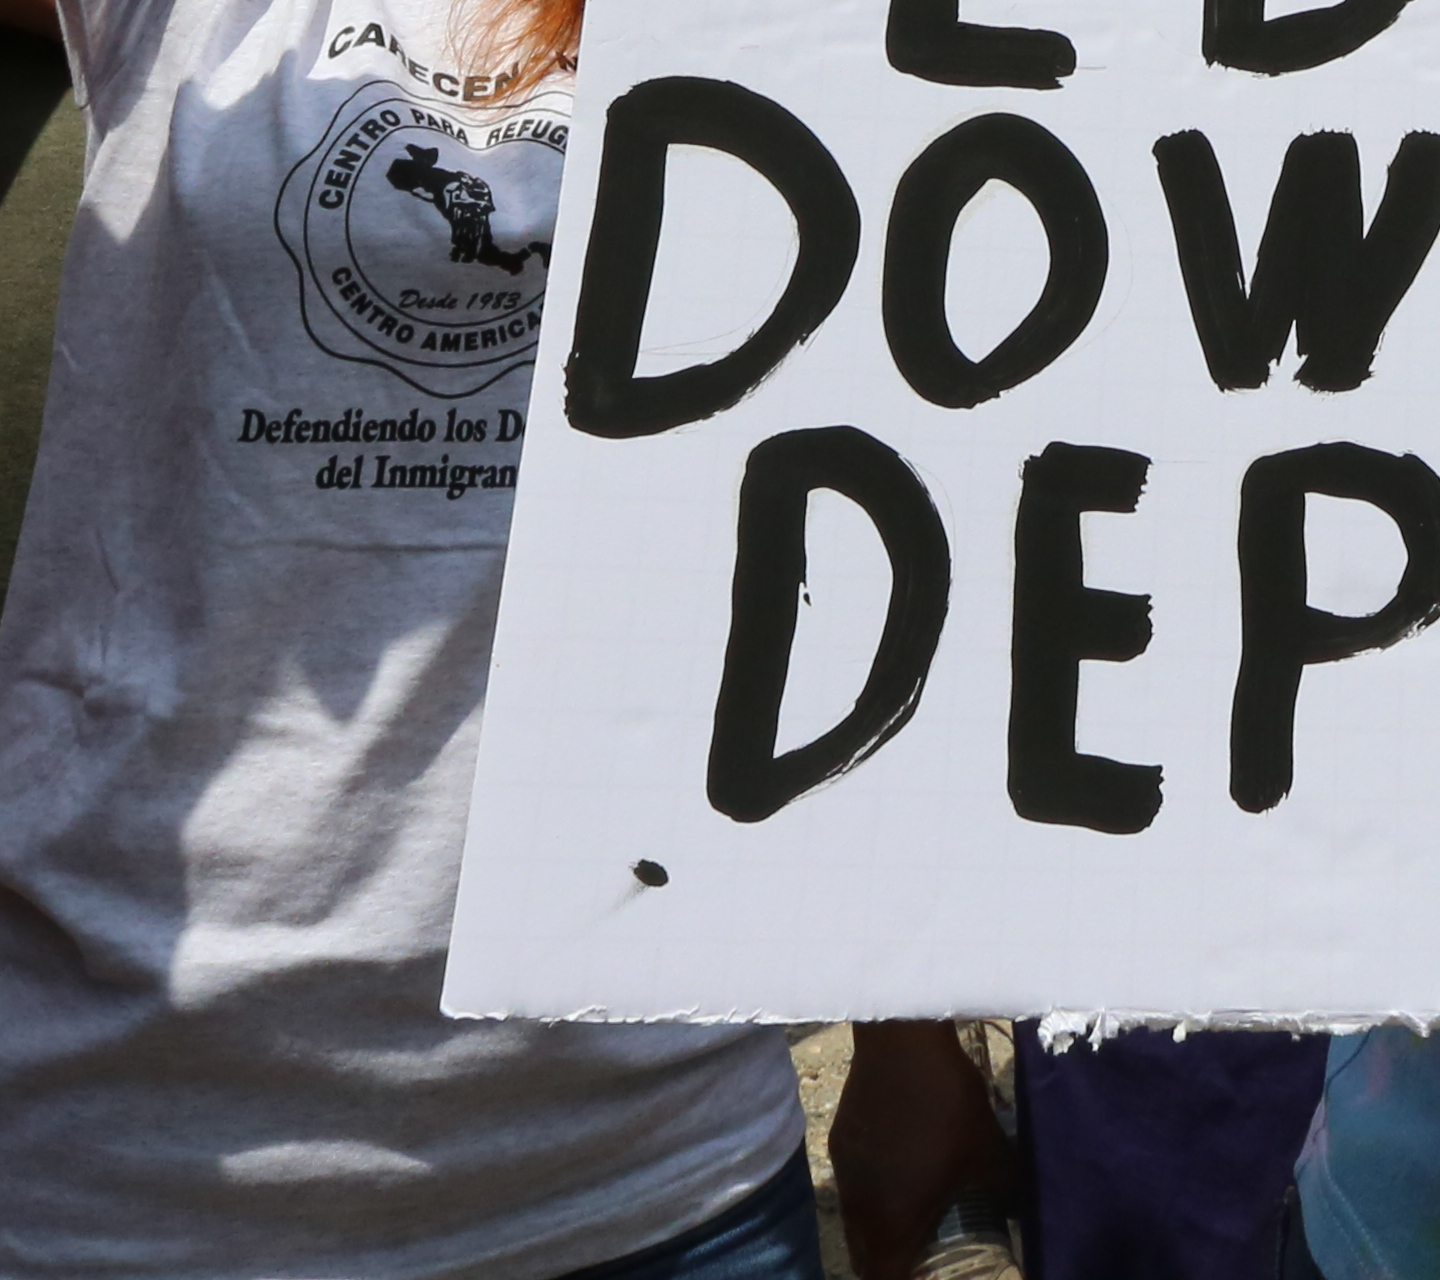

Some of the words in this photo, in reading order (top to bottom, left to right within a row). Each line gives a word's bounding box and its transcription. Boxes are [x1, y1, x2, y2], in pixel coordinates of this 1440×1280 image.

[327, 22, 520, 103] CARECEN
[318, 108, 402, 210] CENTRO
[410, 107, 470, 146] PARA
[331, 266, 416, 345] CENTRO
[419, 302, 545, 352] AMERICA
[399, 287, 459, 311] Desde
[466, 290, 522, 310] 1983
[237, 406, 438, 444] Defendiendo
[443, 408, 487, 443] los
[315, 455, 362, 490] del
[369, 454, 518, 500] Inmigran
